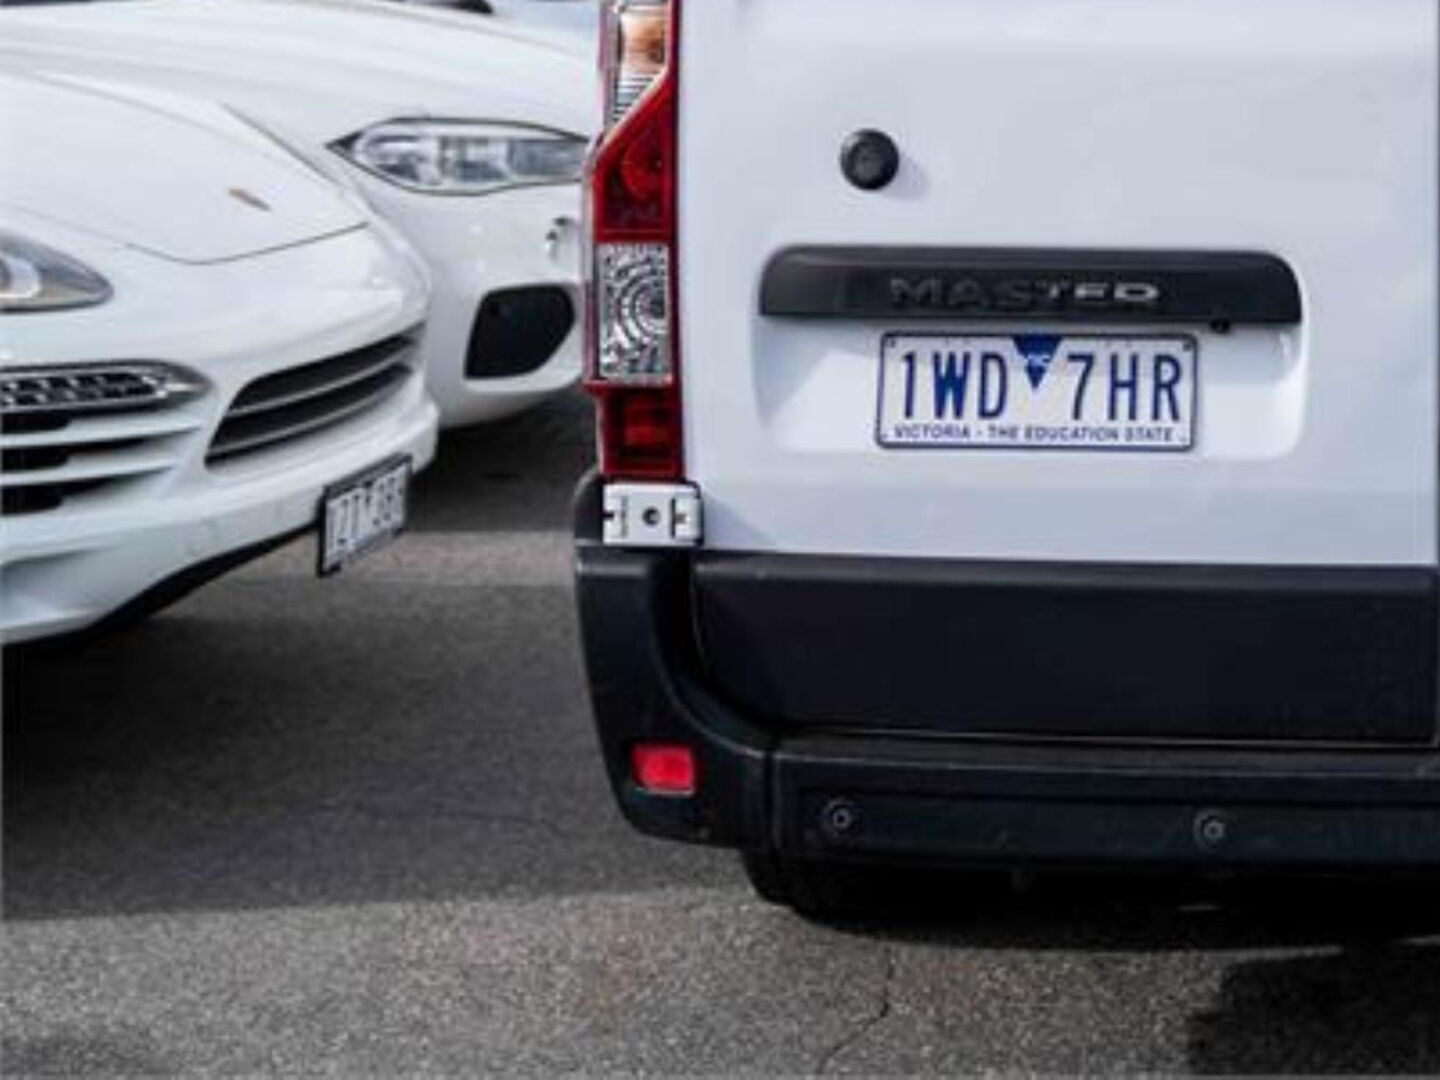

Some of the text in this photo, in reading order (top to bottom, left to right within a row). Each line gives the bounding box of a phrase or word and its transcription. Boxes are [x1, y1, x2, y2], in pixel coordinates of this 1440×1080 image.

[902, 351, 1182, 421] 1WD 7HR
[894, 424, 970, 439] VICTORIA
[988, 425, 1018, 439] THE
[1024, 425, 1119, 440] EDUCATION
[1125, 427, 1174, 441] STATE
